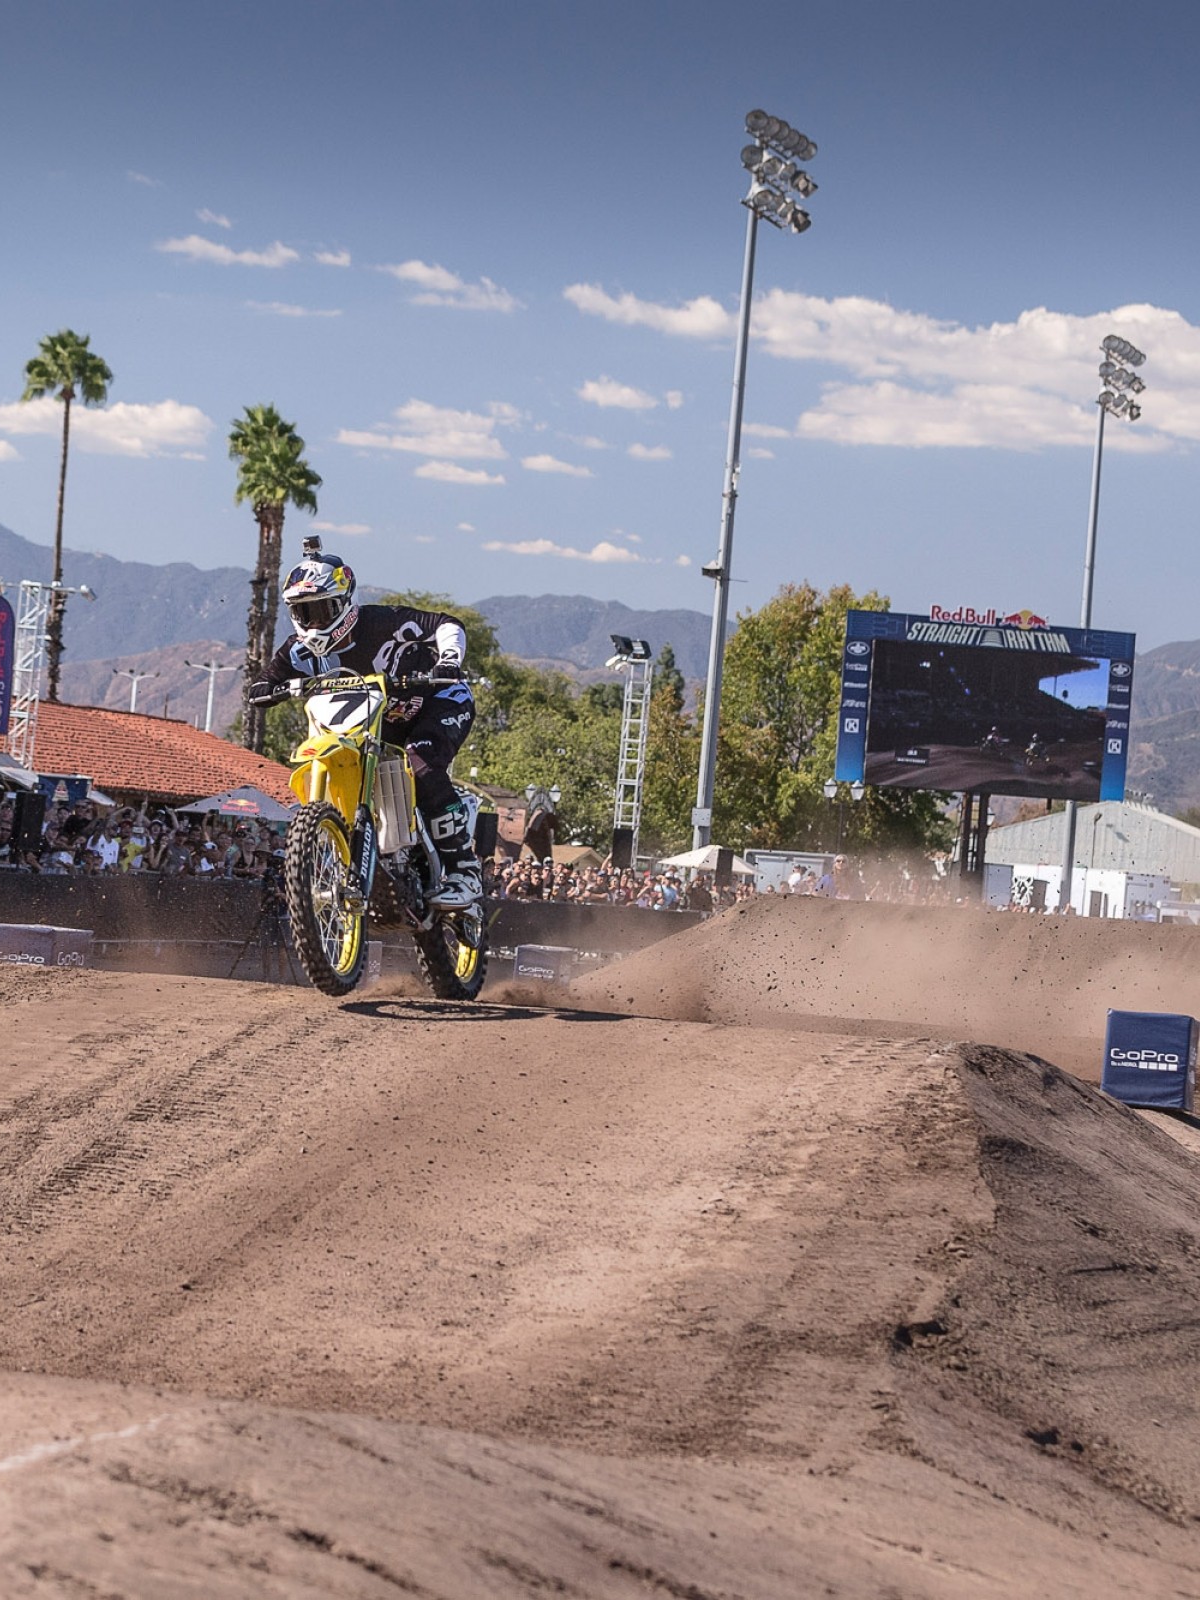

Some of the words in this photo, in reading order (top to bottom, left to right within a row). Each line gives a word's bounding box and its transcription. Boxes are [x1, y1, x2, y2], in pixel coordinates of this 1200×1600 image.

[930, 604, 963, 623] Red
[964, 607, 997, 626] Bull
[906, 622, 980, 645] STRAIGHT
[1005, 631, 1071, 654] RHYTHM
[329, 692, 369, 726] 7
[360, 821, 373, 879] DUNLOP
[518, 965, 554, 974] GoPro
[1110, 1048, 1179, 1062] GoPro
